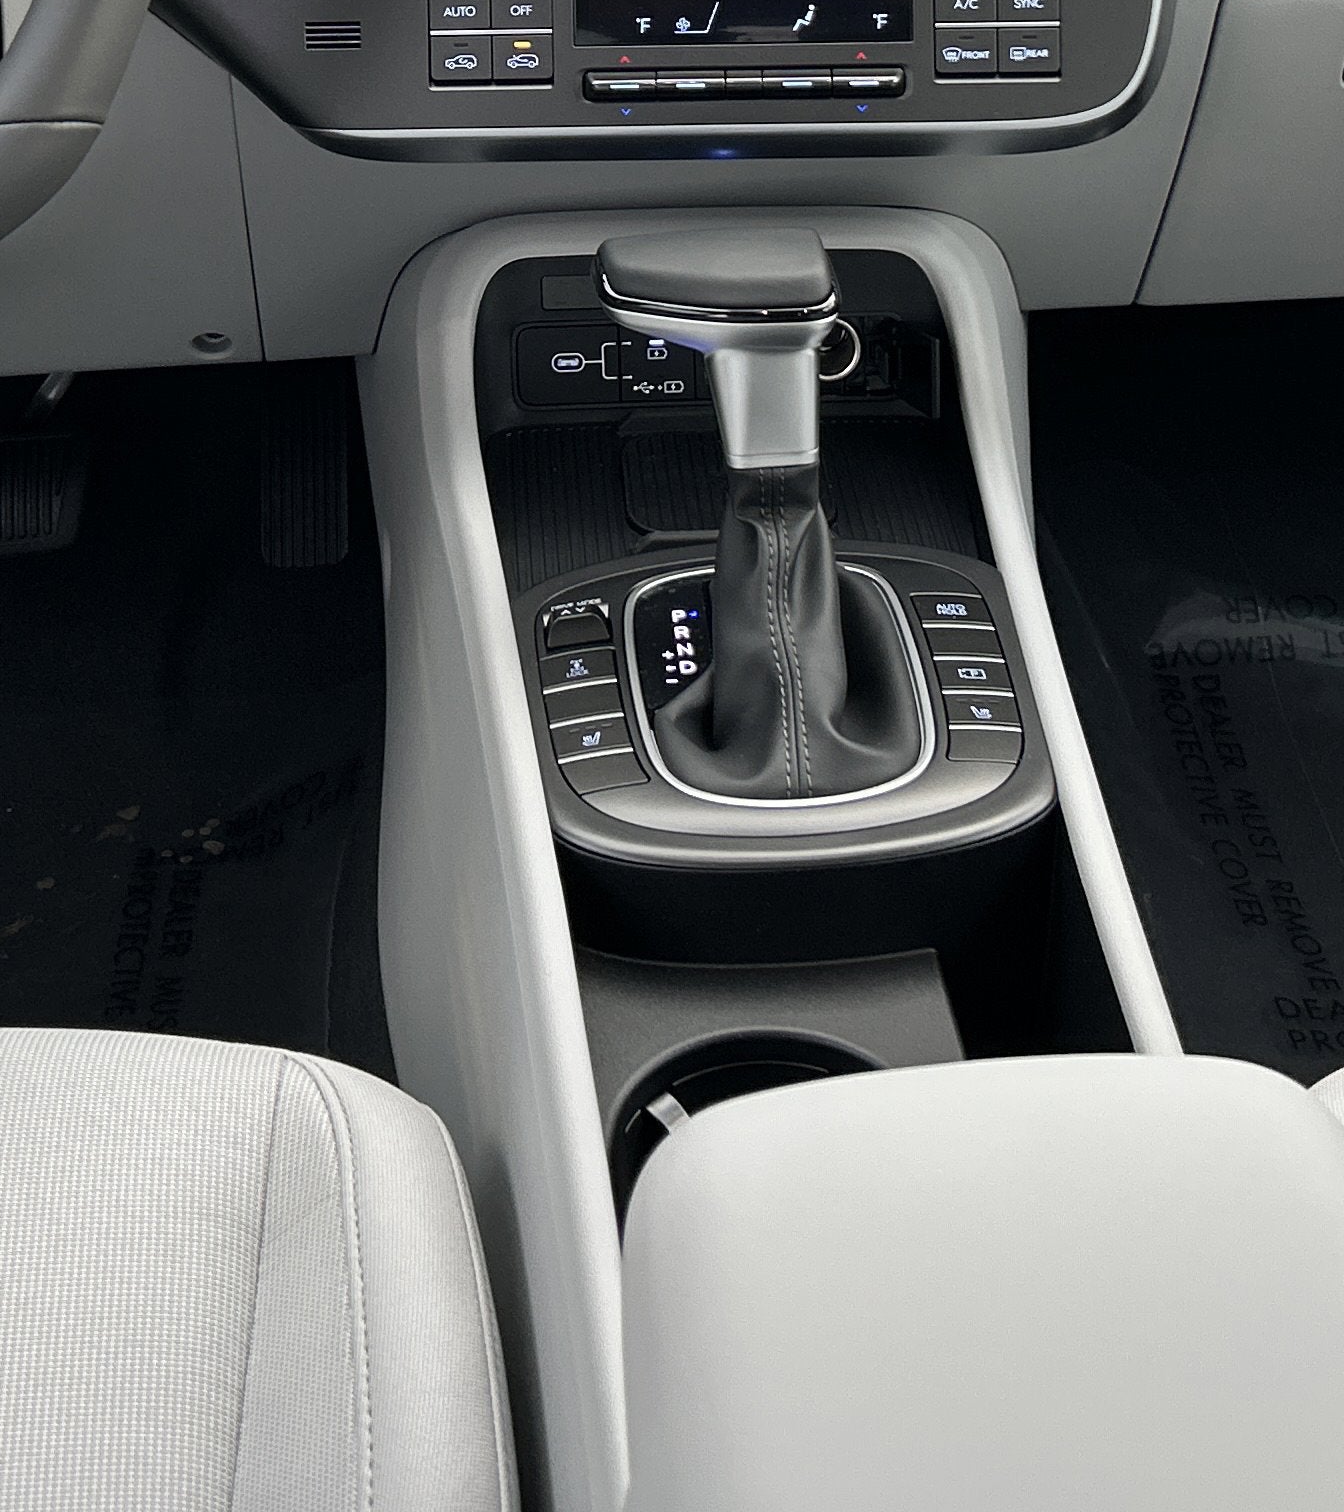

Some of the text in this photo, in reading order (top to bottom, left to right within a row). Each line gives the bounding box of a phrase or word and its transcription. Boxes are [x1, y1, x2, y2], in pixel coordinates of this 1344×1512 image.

[443, 5, 477, 17] AUTO
[509, 5, 533, 16] OFF
[961, 50, 990, 60] FRONT
[1026, 48, 1048, 58] REAR
[671, 609, 687, 623] P
[673, 625, 690, 640] R
[676, 642, 694, 657] N
[679, 660, 698, 676] D
[1152, 673, 1269, 928] PROTECTIVE COVER
[1231, 788, 1284, 864] MUST
[1265, 878, 1343, 992] REMOVE
